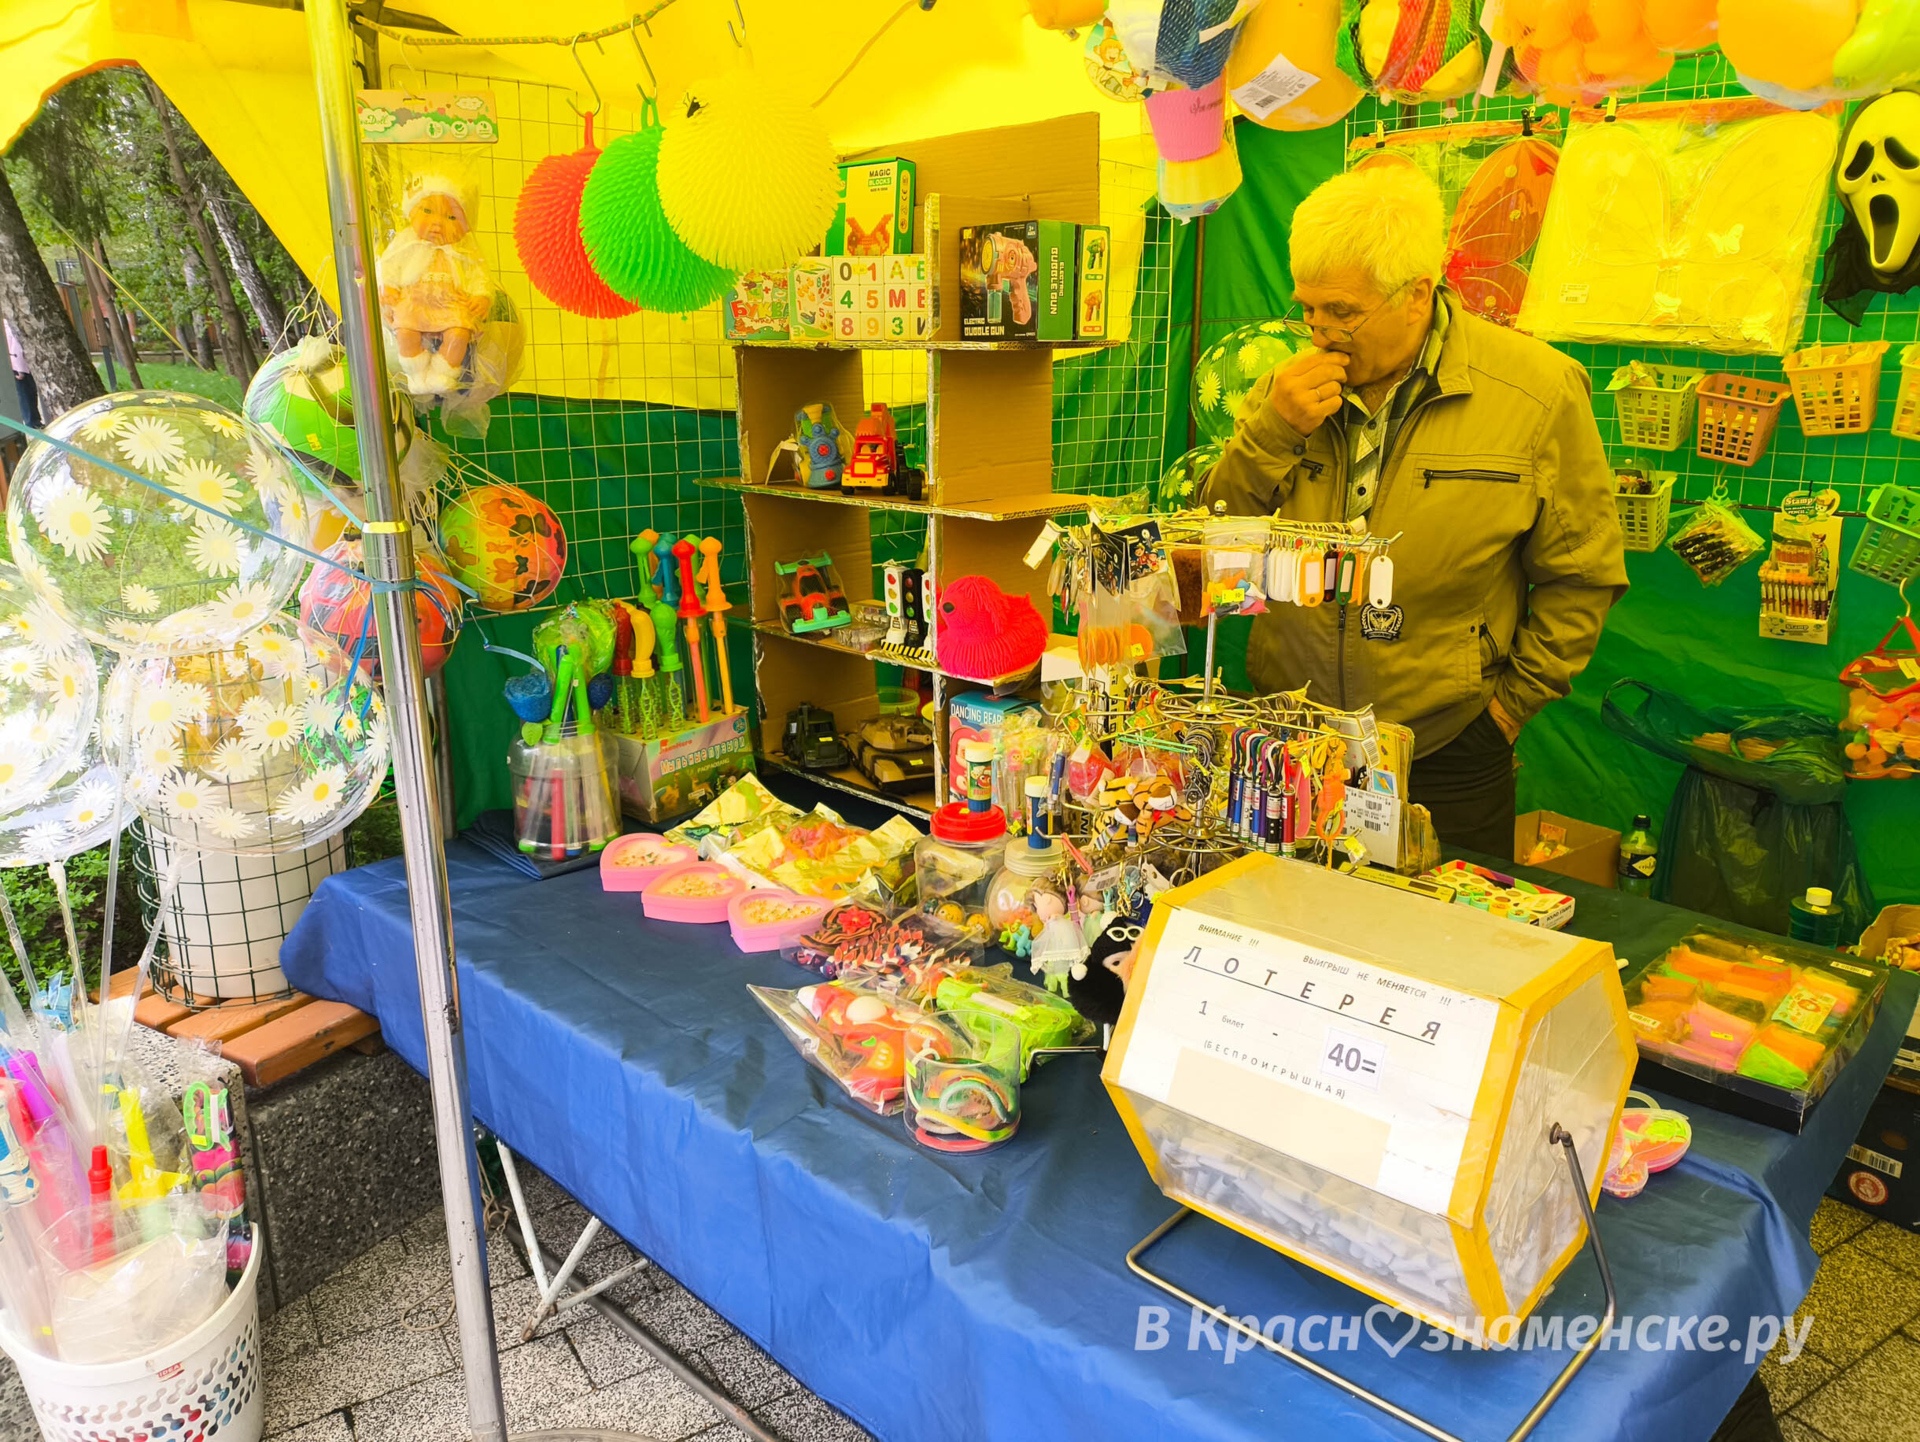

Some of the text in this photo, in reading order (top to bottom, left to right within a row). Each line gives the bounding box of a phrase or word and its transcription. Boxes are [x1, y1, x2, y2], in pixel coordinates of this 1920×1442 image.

[869, 168, 891, 177] MAGIC
[869, 177, 891, 187] BLOCKS
[867, 262, 877, 281] 1
[1050, 247, 1059, 315] BUBBLE GUN
[840, 289, 853, 309] 4
[866, 290, 879, 308] 5
[841, 317, 854, 336] 8
[866, 317, 879, 336] 9
[990, 325, 1005, 335] GUN
[1785, 497, 1814, 506] Stamp
[950, 703, 982, 722] DANCING
[1198, 923, 1243, 943] ВНИМАНИЕ
[1302, 954, 1350, 976] ВЫИГРЫШ
[1356, 970, 1370, 982] НЕ
[1376, 977, 1428, 999] МЕНЯЕТСЯ
[1198, 1000, 1208, 1016] 1
[1221, 1014, 1245, 1030] билет
[1327, 1042, 1378, 1075] 40=
[158, 1362, 182, 1378] IDEA
